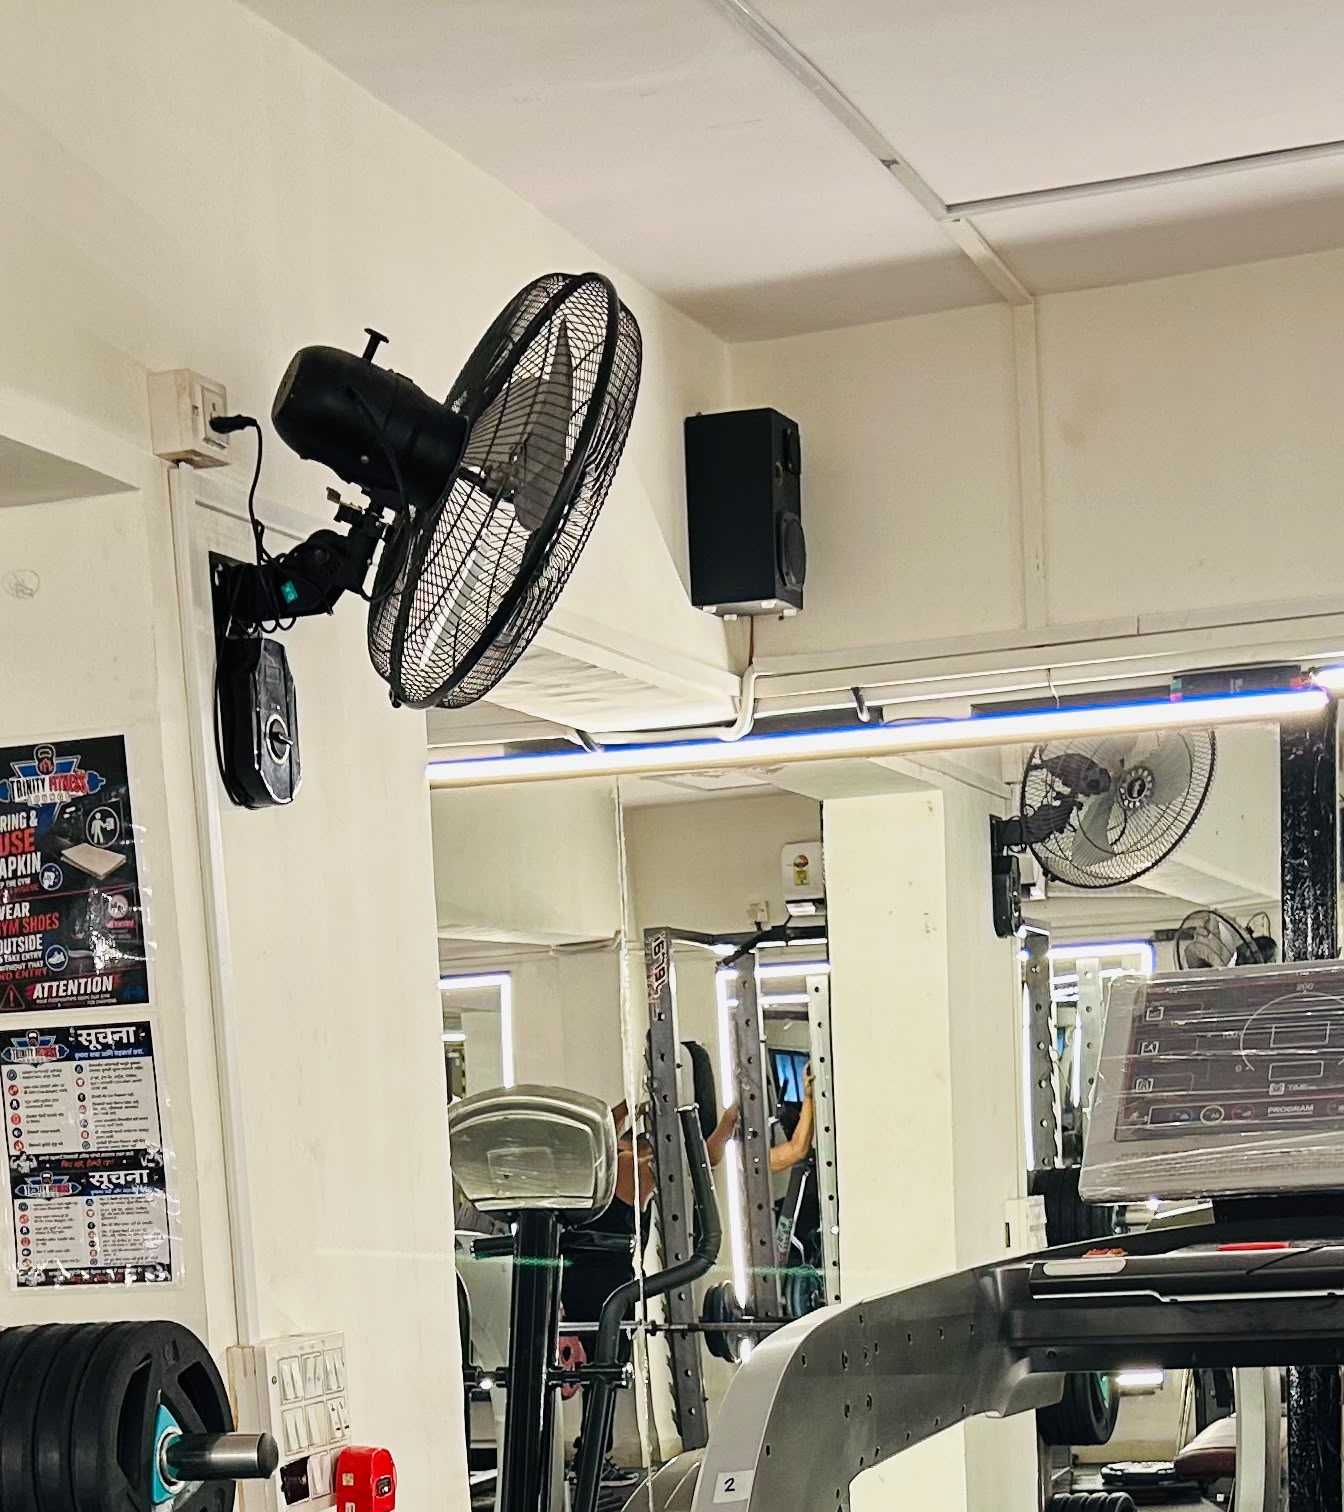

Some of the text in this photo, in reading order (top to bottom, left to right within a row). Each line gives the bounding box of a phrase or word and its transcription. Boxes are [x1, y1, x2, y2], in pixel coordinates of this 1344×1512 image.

[11, 777, 46, 801] TRINITY
[29, 810, 38, 827] &
[22, 912, 60, 933] SHOES
[32, 976, 114, 1000] ATTENTION
[76, 1027, 136, 1050] सूचना
[1267, 1104, 1315, 1114] PROGRAM
[88, 1170, 150, 1190] सूचना
[724, 1477, 736, 1492] 2
